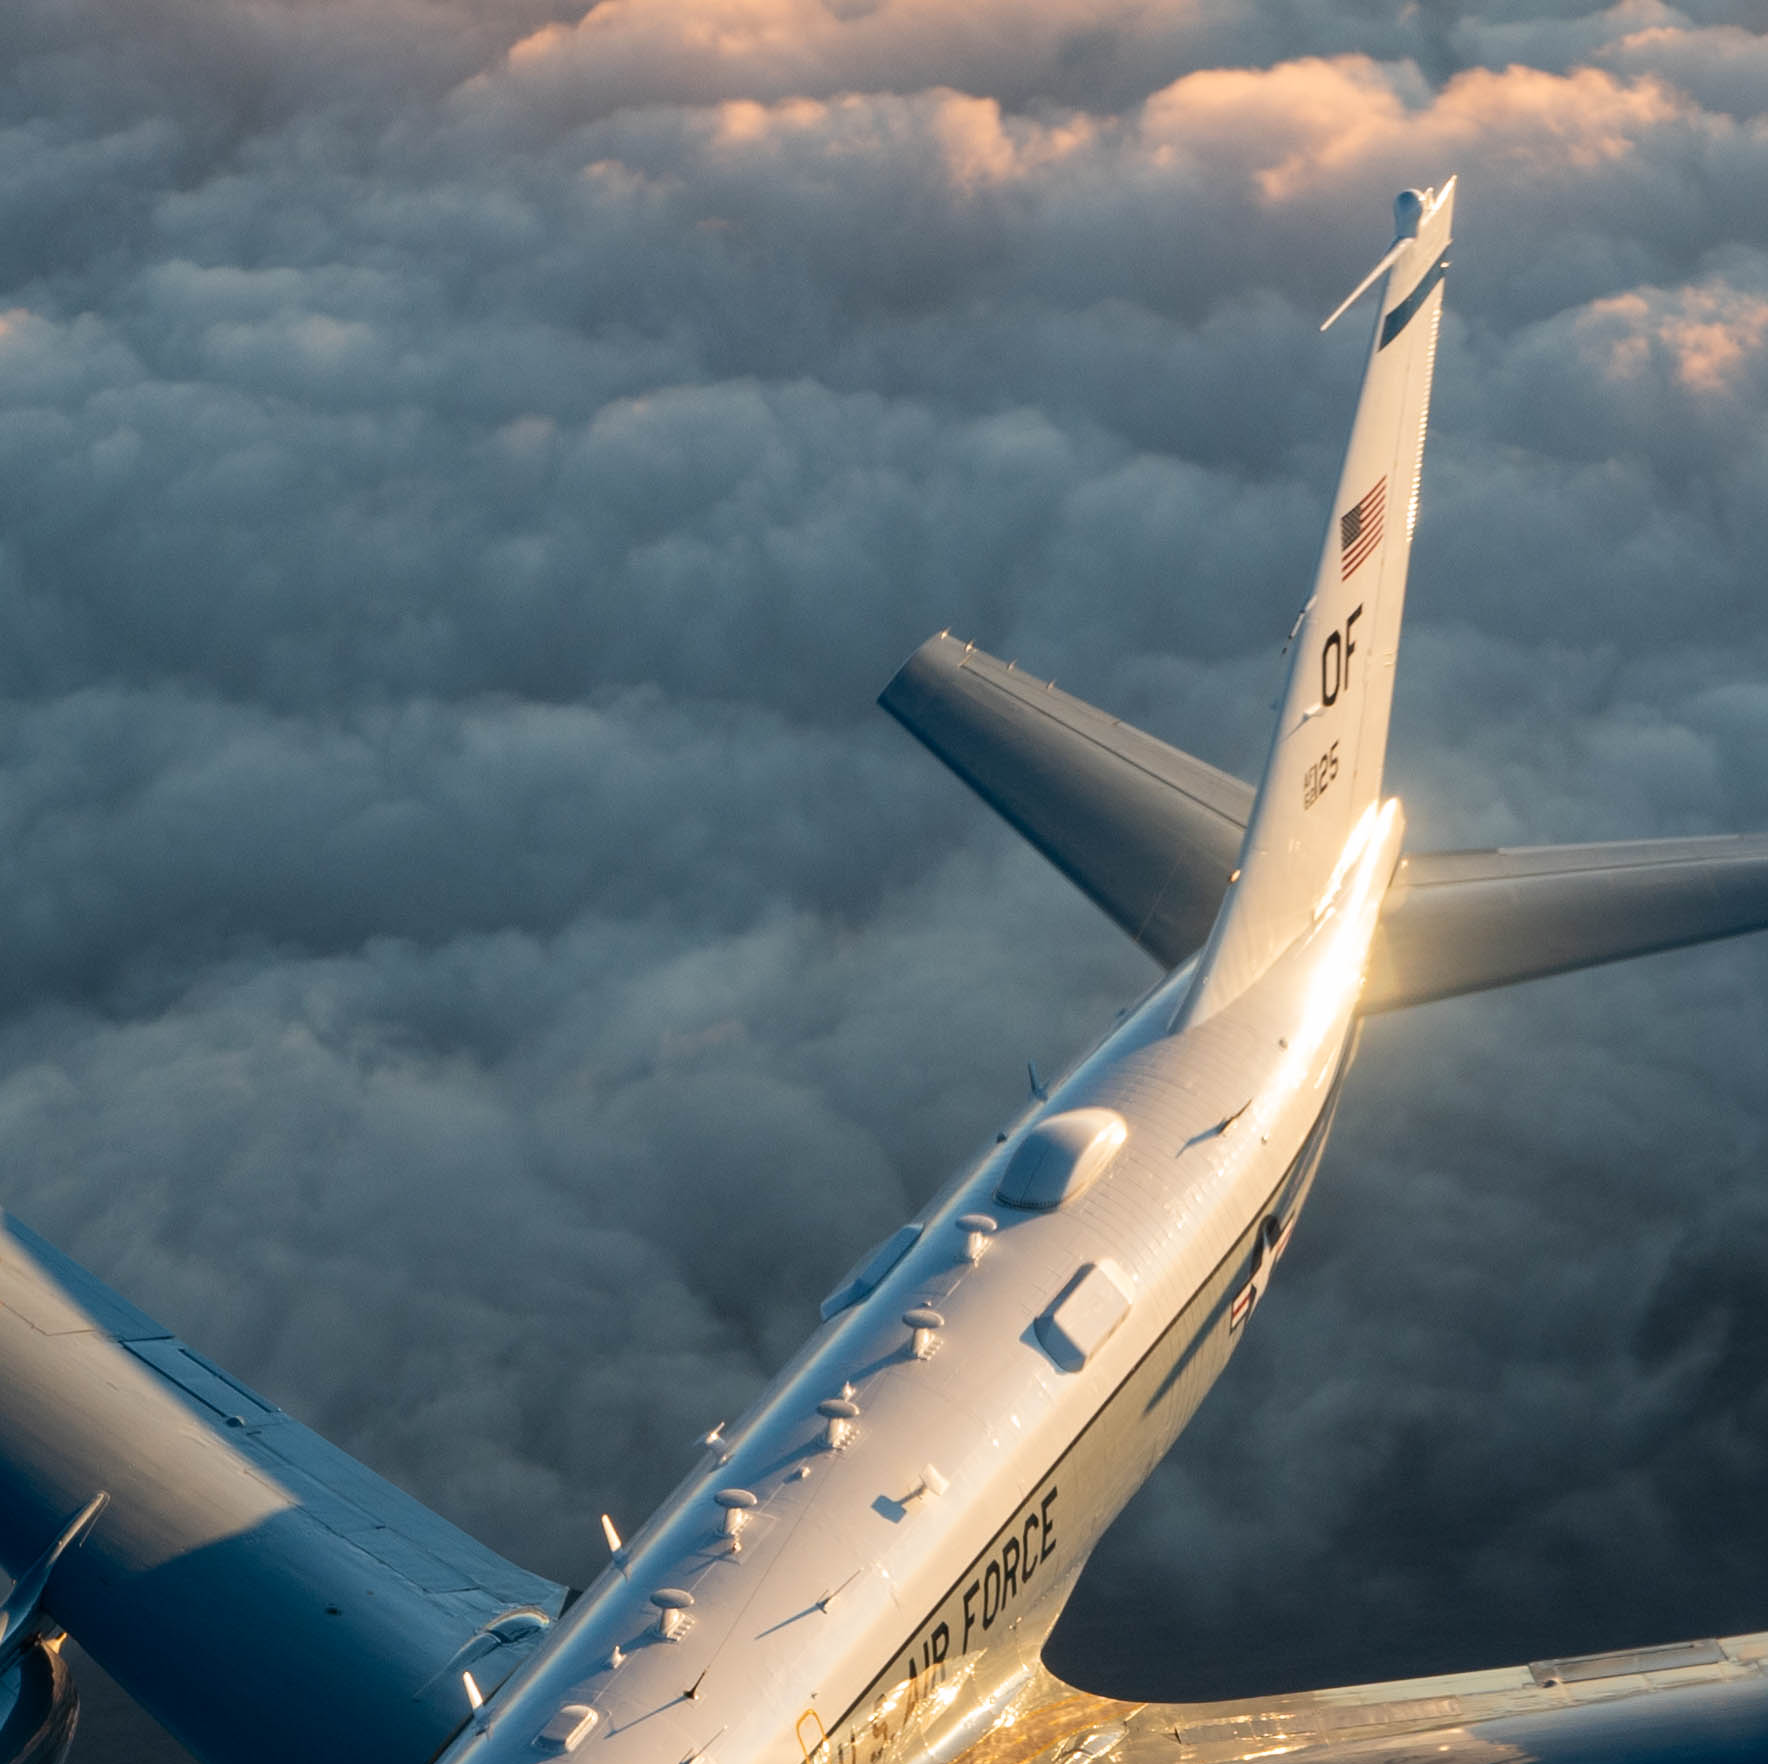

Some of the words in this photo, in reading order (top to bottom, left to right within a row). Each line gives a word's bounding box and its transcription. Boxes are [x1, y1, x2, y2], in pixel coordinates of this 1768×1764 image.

[1322, 602, 1363, 706] OF
[903, 1621, 950, 1727] AIR
[962, 1486, 1059, 1656] FORCE
